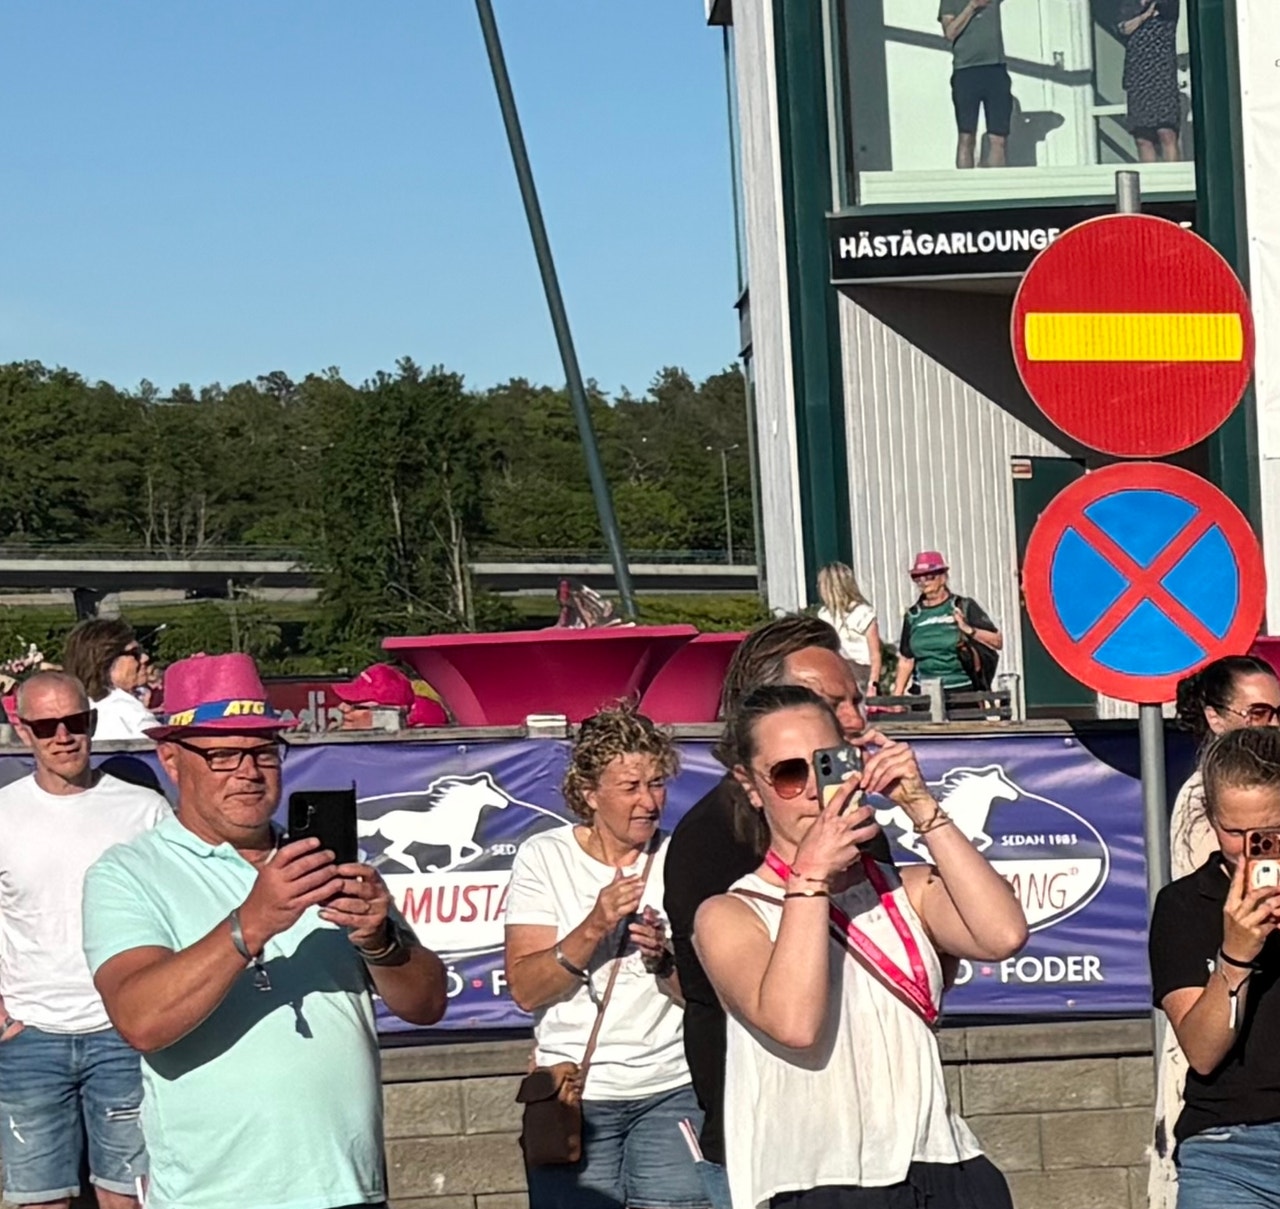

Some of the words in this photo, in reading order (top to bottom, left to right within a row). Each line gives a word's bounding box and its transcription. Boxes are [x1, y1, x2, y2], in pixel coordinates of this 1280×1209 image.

[222, 700, 266, 717] ATG
[1000, 834, 1045, 847] SEDAN
[402, 883, 508, 925] MUST
[999, 955, 1104, 984] FODER
